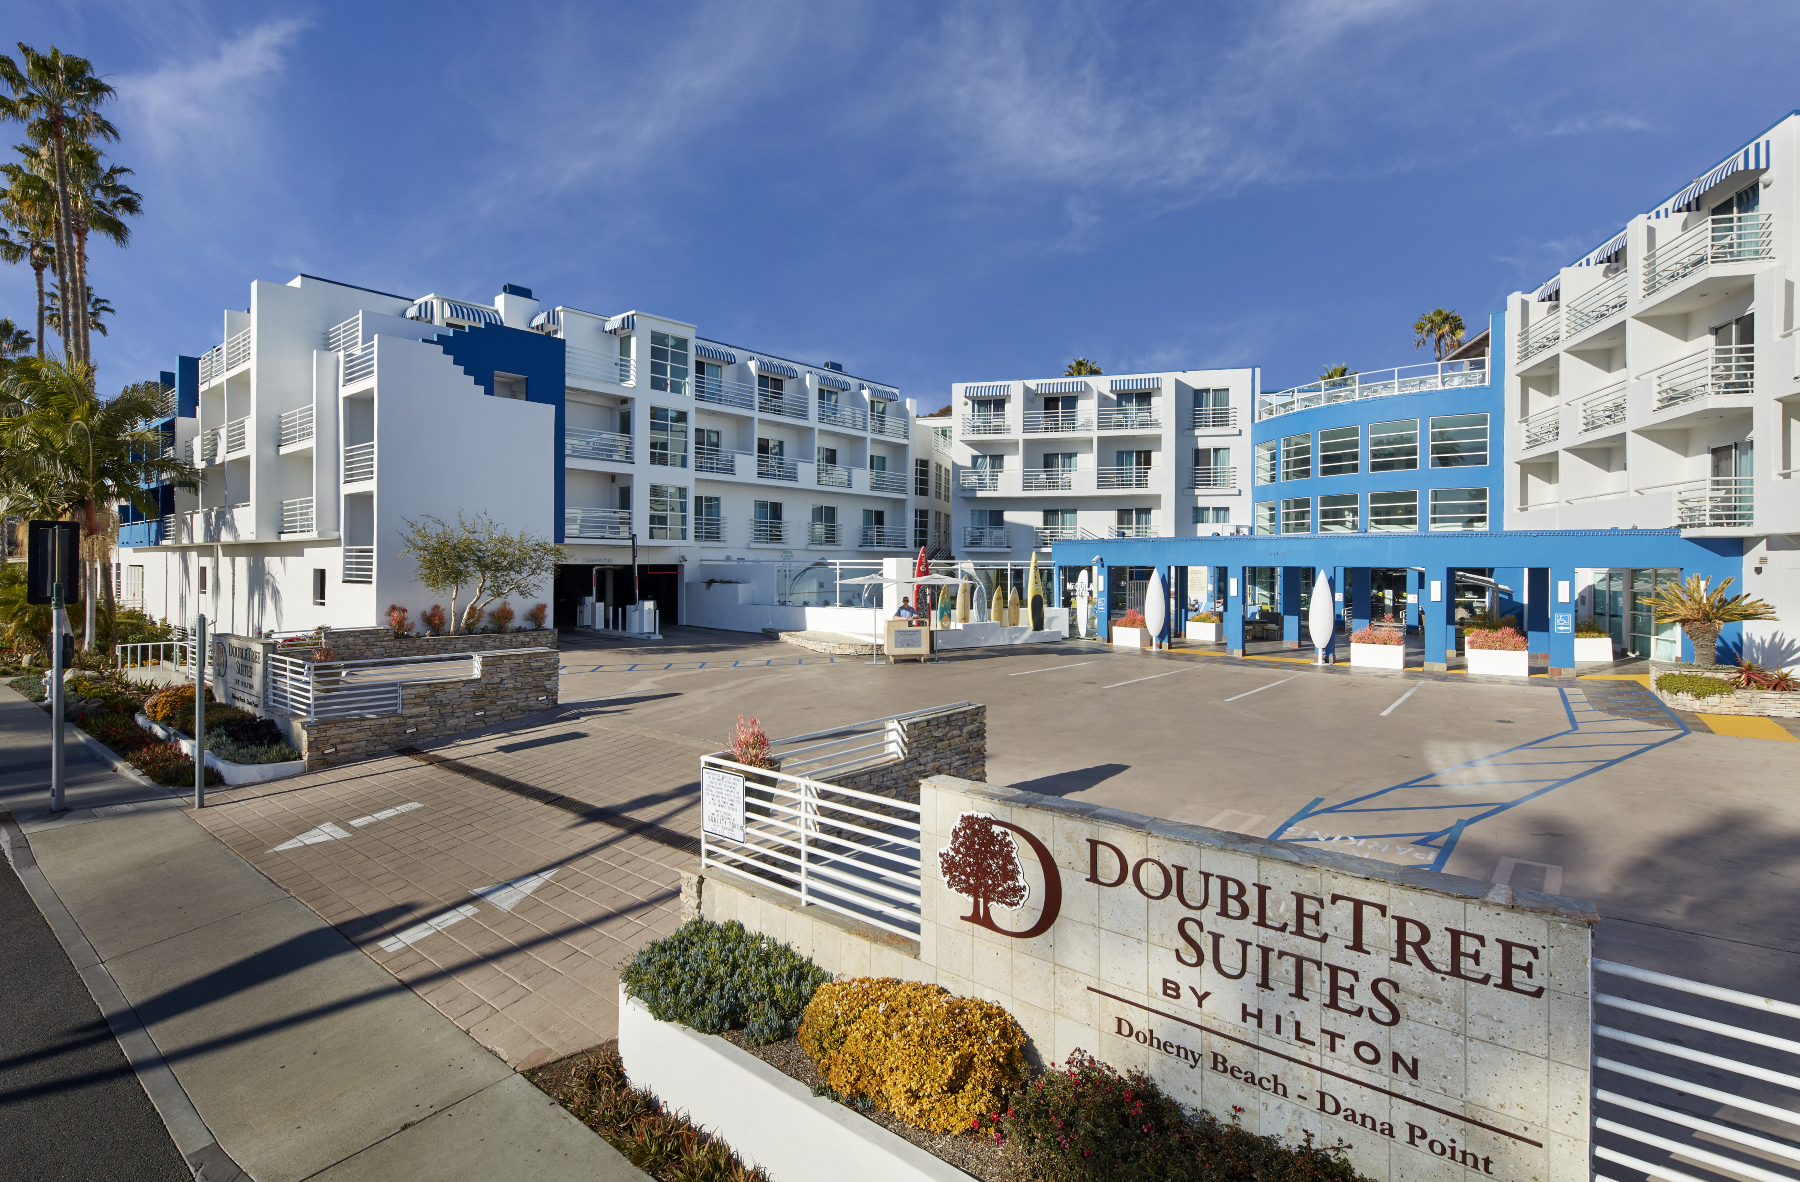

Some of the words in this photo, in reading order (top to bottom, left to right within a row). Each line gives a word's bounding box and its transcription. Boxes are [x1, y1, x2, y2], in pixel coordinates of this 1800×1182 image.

[228, 643, 261, 664] DOUBLETREE
[235, 661, 253, 678] SUITES
[1283, 826, 1438, 861] PARKING
[1085, 838, 1545, 998] DOUBLETREE
[1174, 916, 1401, 1027] SUITES
[1162, 977, 1211, 1008] BY
[1241, 1002, 1419, 1081] HILTON
[1114, 1016, 1203, 1069] Doheny
[1211, 1050, 1289, 1099] Beach
[1316, 1090, 1396, 1139] Dana
[1405, 1121, 1494, 1175] Point
